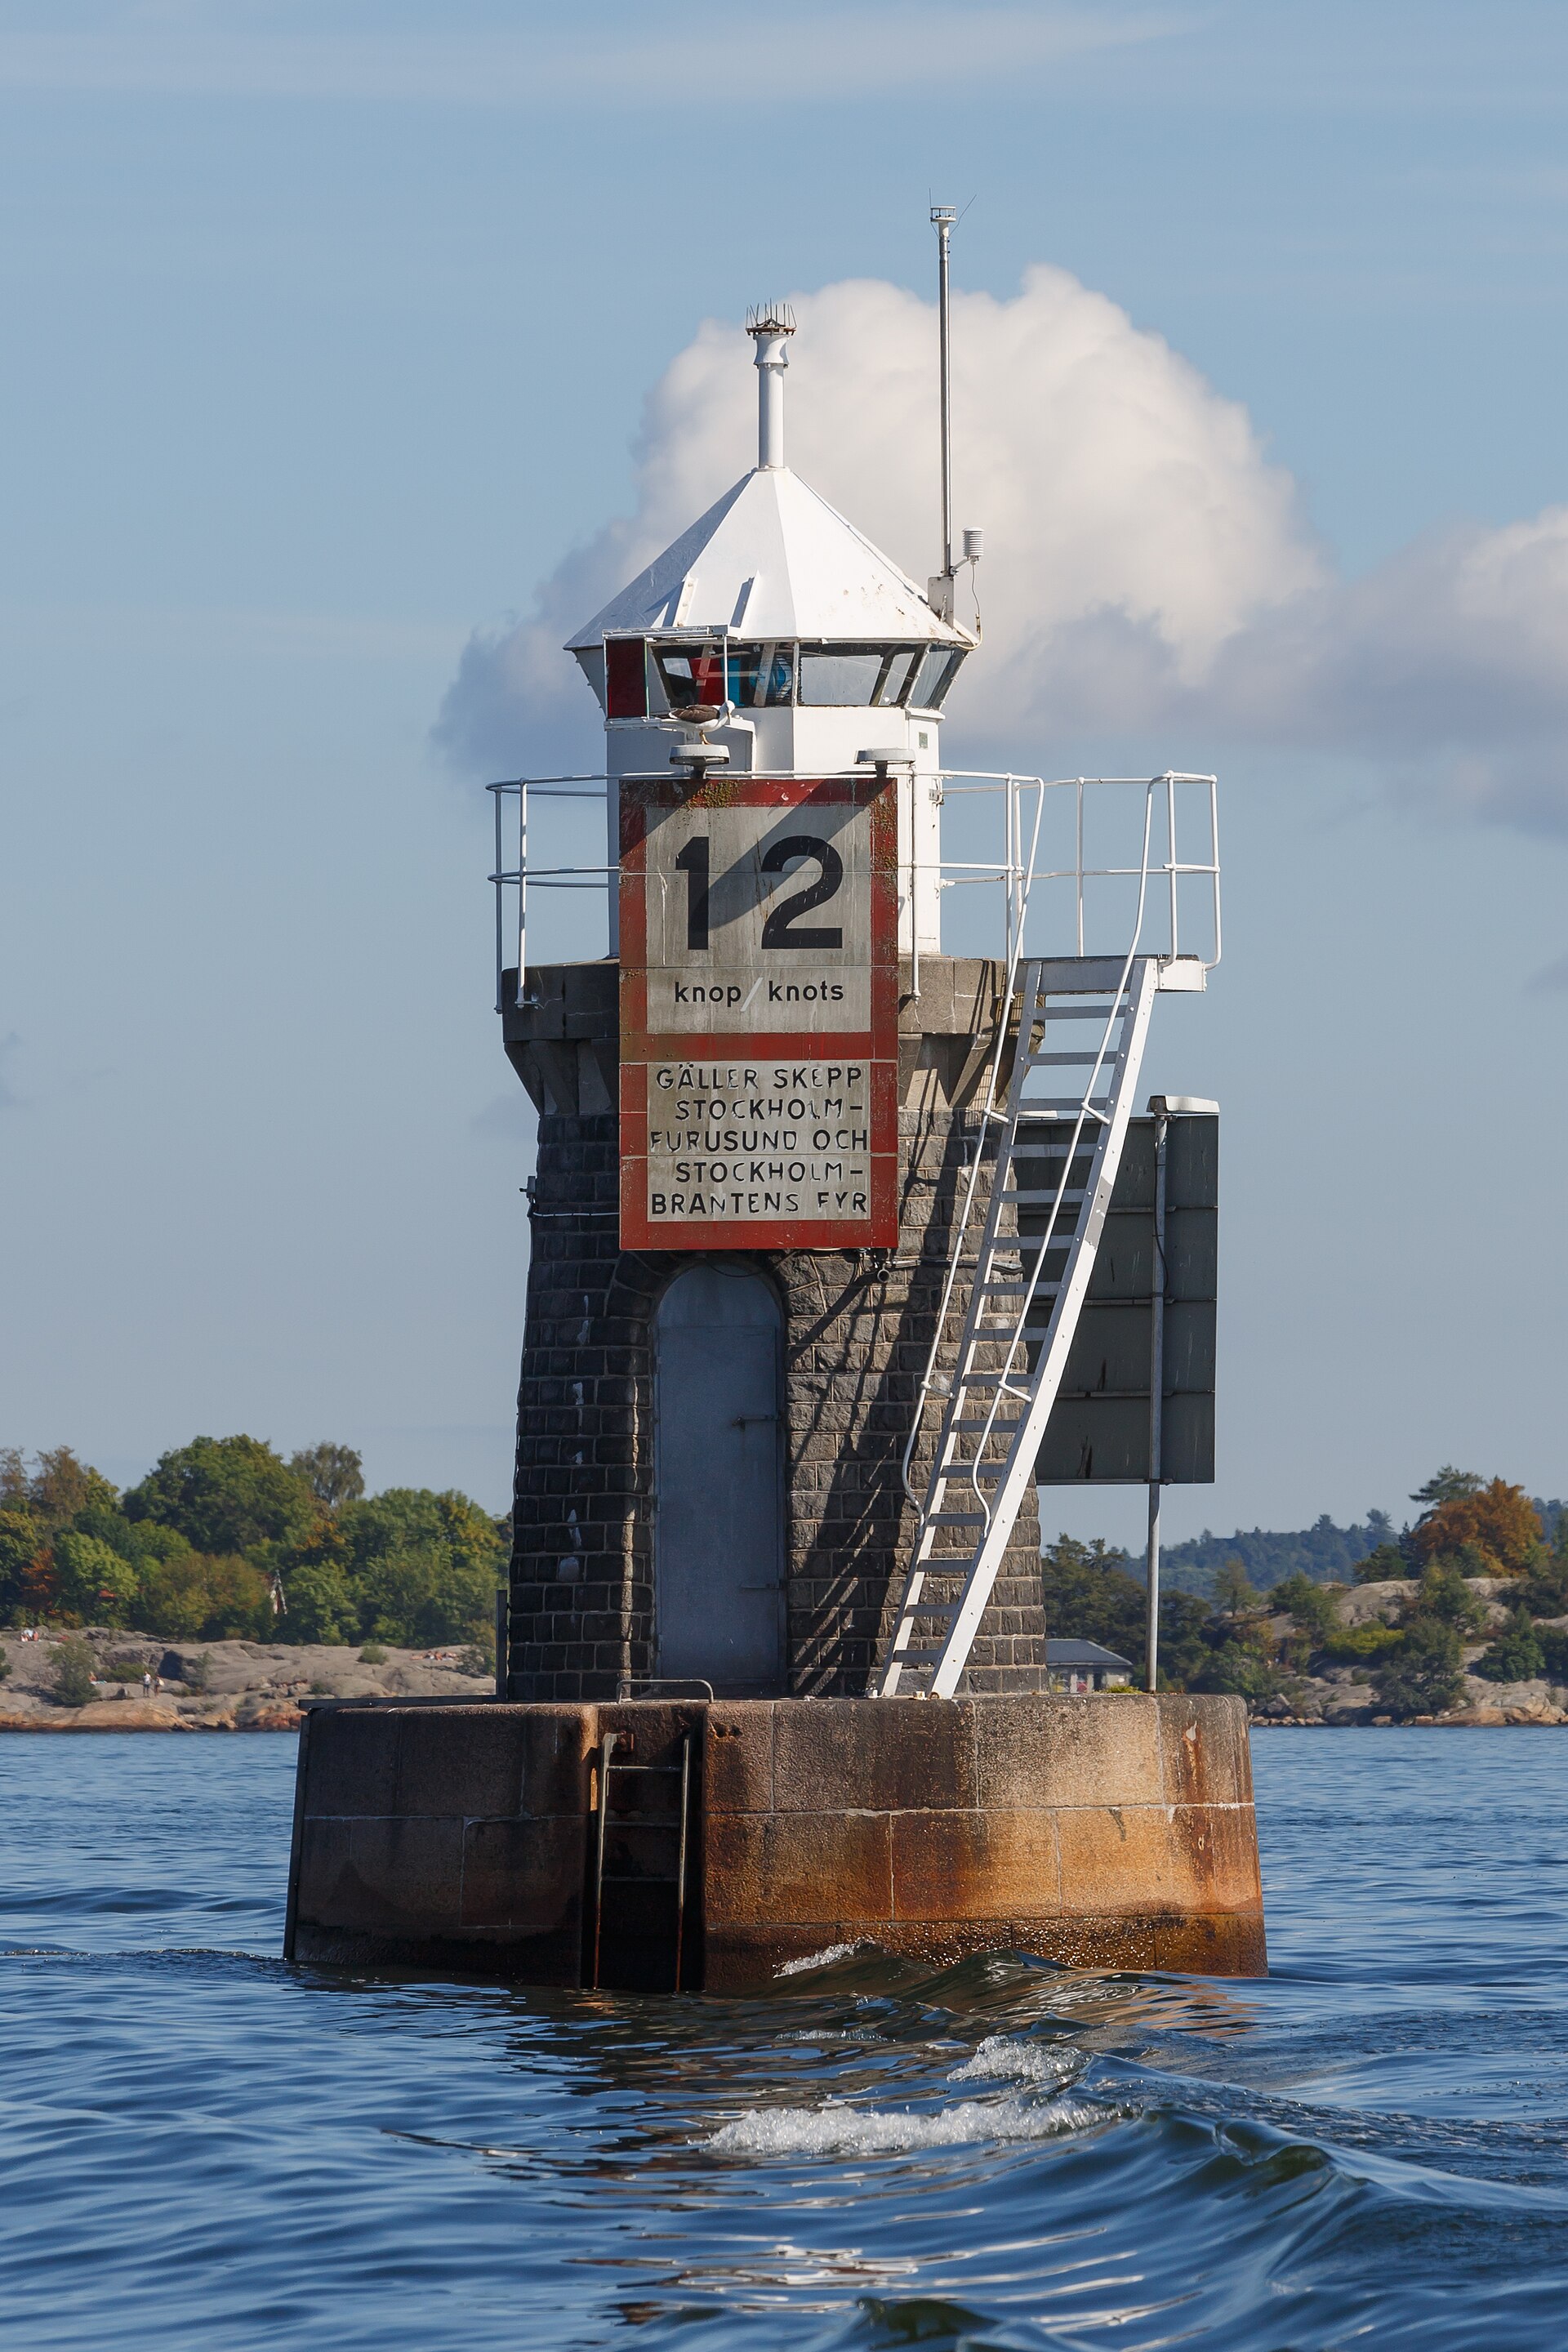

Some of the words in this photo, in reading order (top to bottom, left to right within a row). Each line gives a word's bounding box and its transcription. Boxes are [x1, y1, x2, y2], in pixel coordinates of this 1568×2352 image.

[656, 1062, 759, 1090] GÄLLER
[773, 1067, 862, 1089] SKEPP
[650, 1130, 798, 1153] FURUSUND
[813, 1129, 868, 1152] OCH
[651, 1192, 800, 1215] BRANTENS
[817, 1191, 867, 1213] FYR
